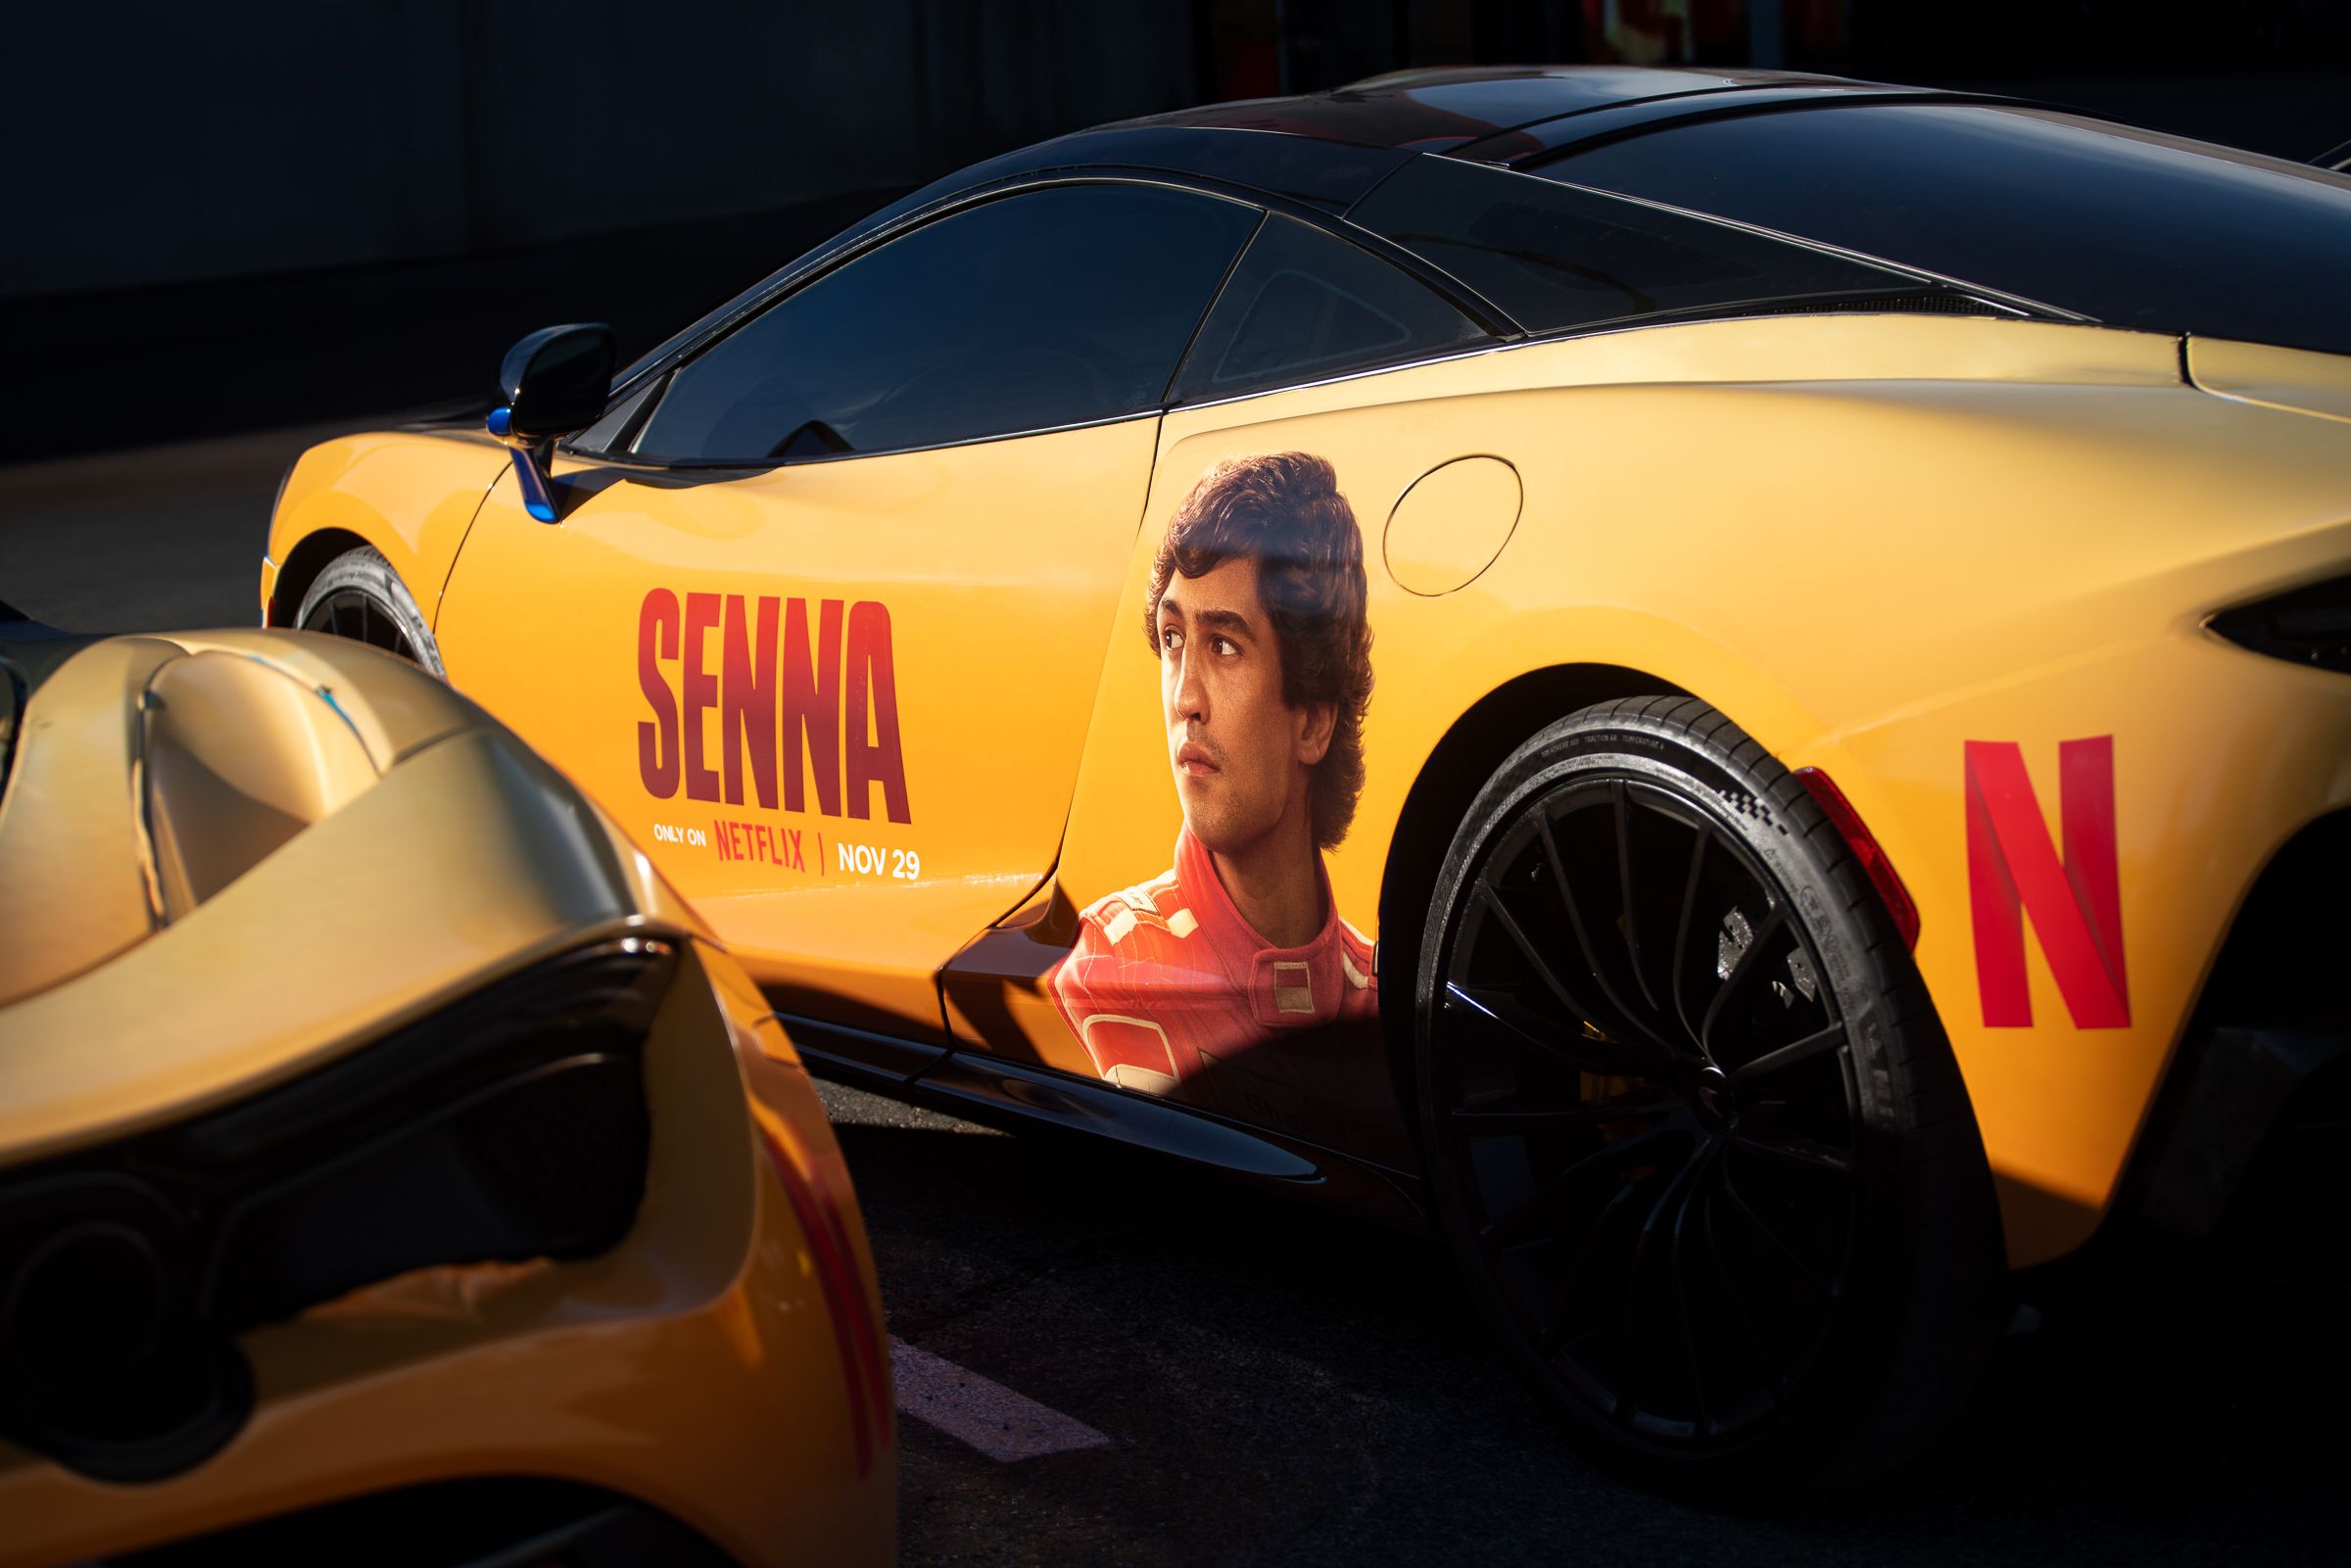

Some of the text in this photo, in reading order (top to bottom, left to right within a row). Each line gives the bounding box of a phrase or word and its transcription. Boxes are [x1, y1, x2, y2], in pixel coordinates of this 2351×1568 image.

[638, 587, 911, 825] SENNA
[653, 819, 920, 880] ONLY ON NETFLIX NOV 29
[1964, 734, 2132, 1030] N
